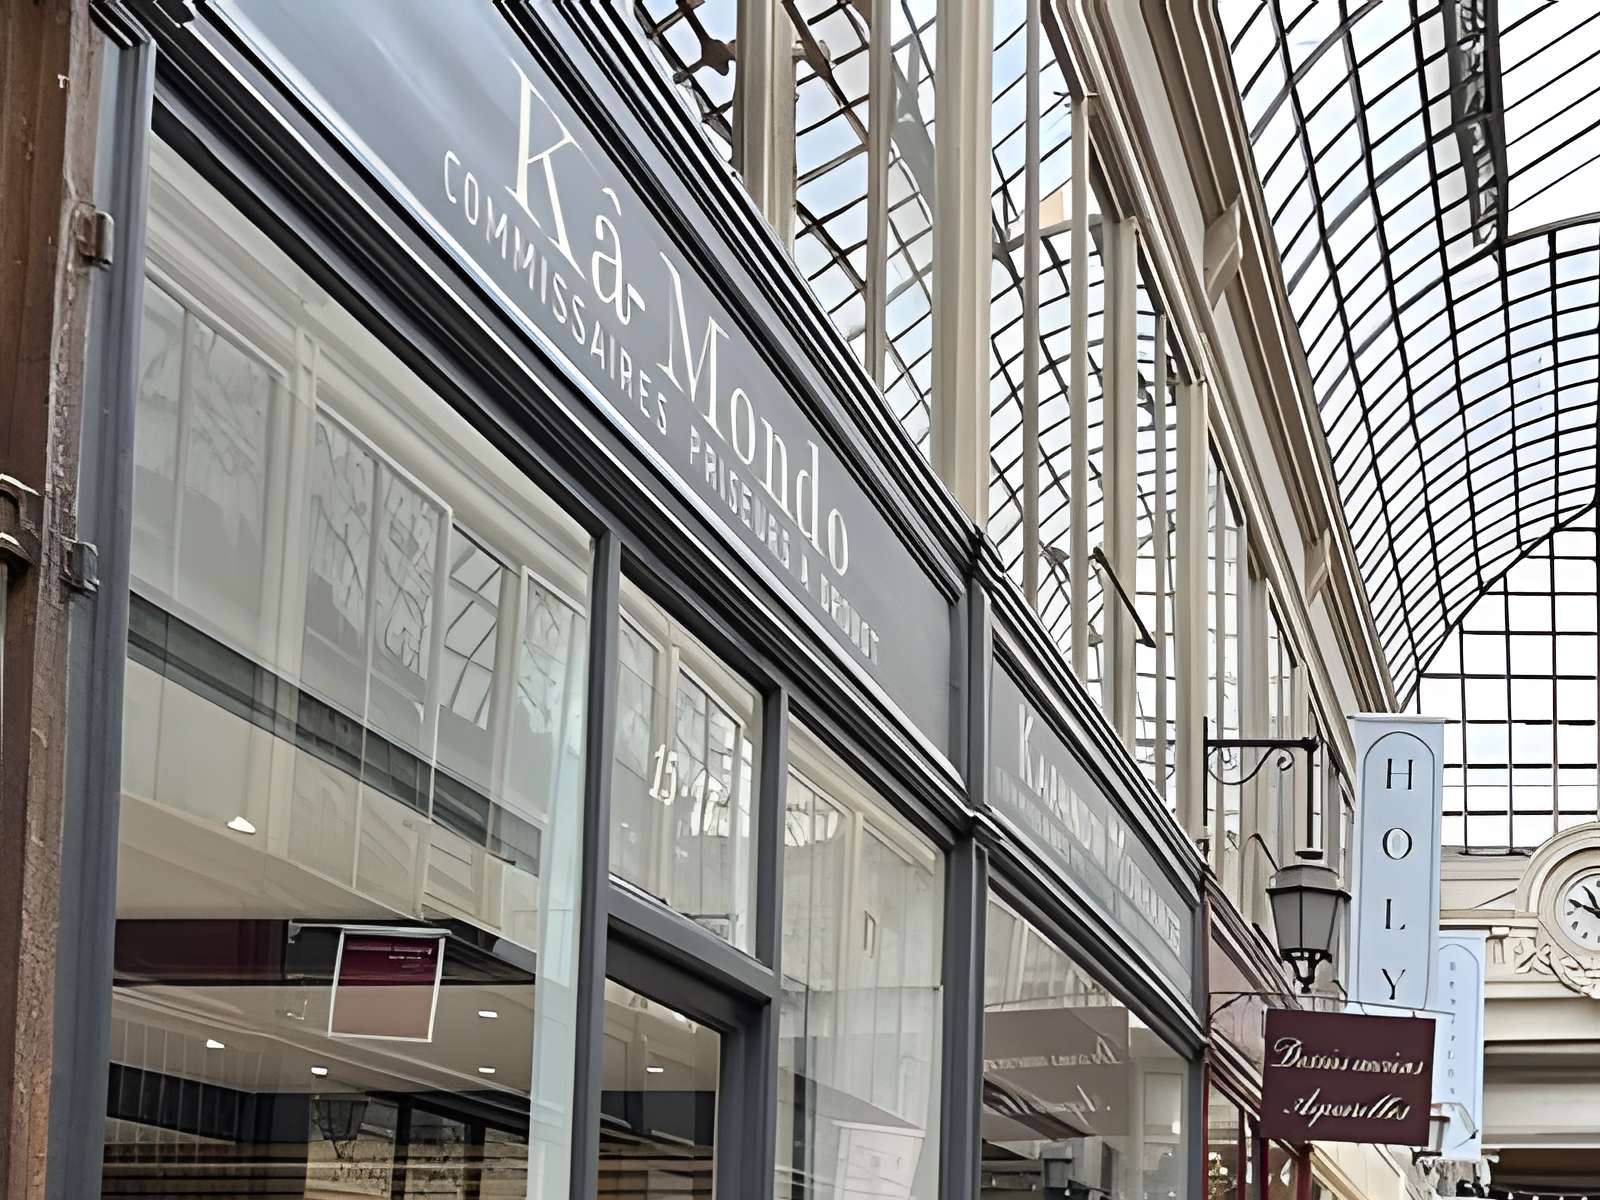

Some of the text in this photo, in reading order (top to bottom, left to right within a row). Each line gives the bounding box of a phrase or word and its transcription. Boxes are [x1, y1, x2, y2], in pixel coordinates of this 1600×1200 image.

[444, 150, 668, 437] COMMISSAIRES
[690, 424, 791, 570] PRISEURS
[507, 53, 850, 577] Kâ-Mondo
[1382, 758, 1413, 1001] HOLY
